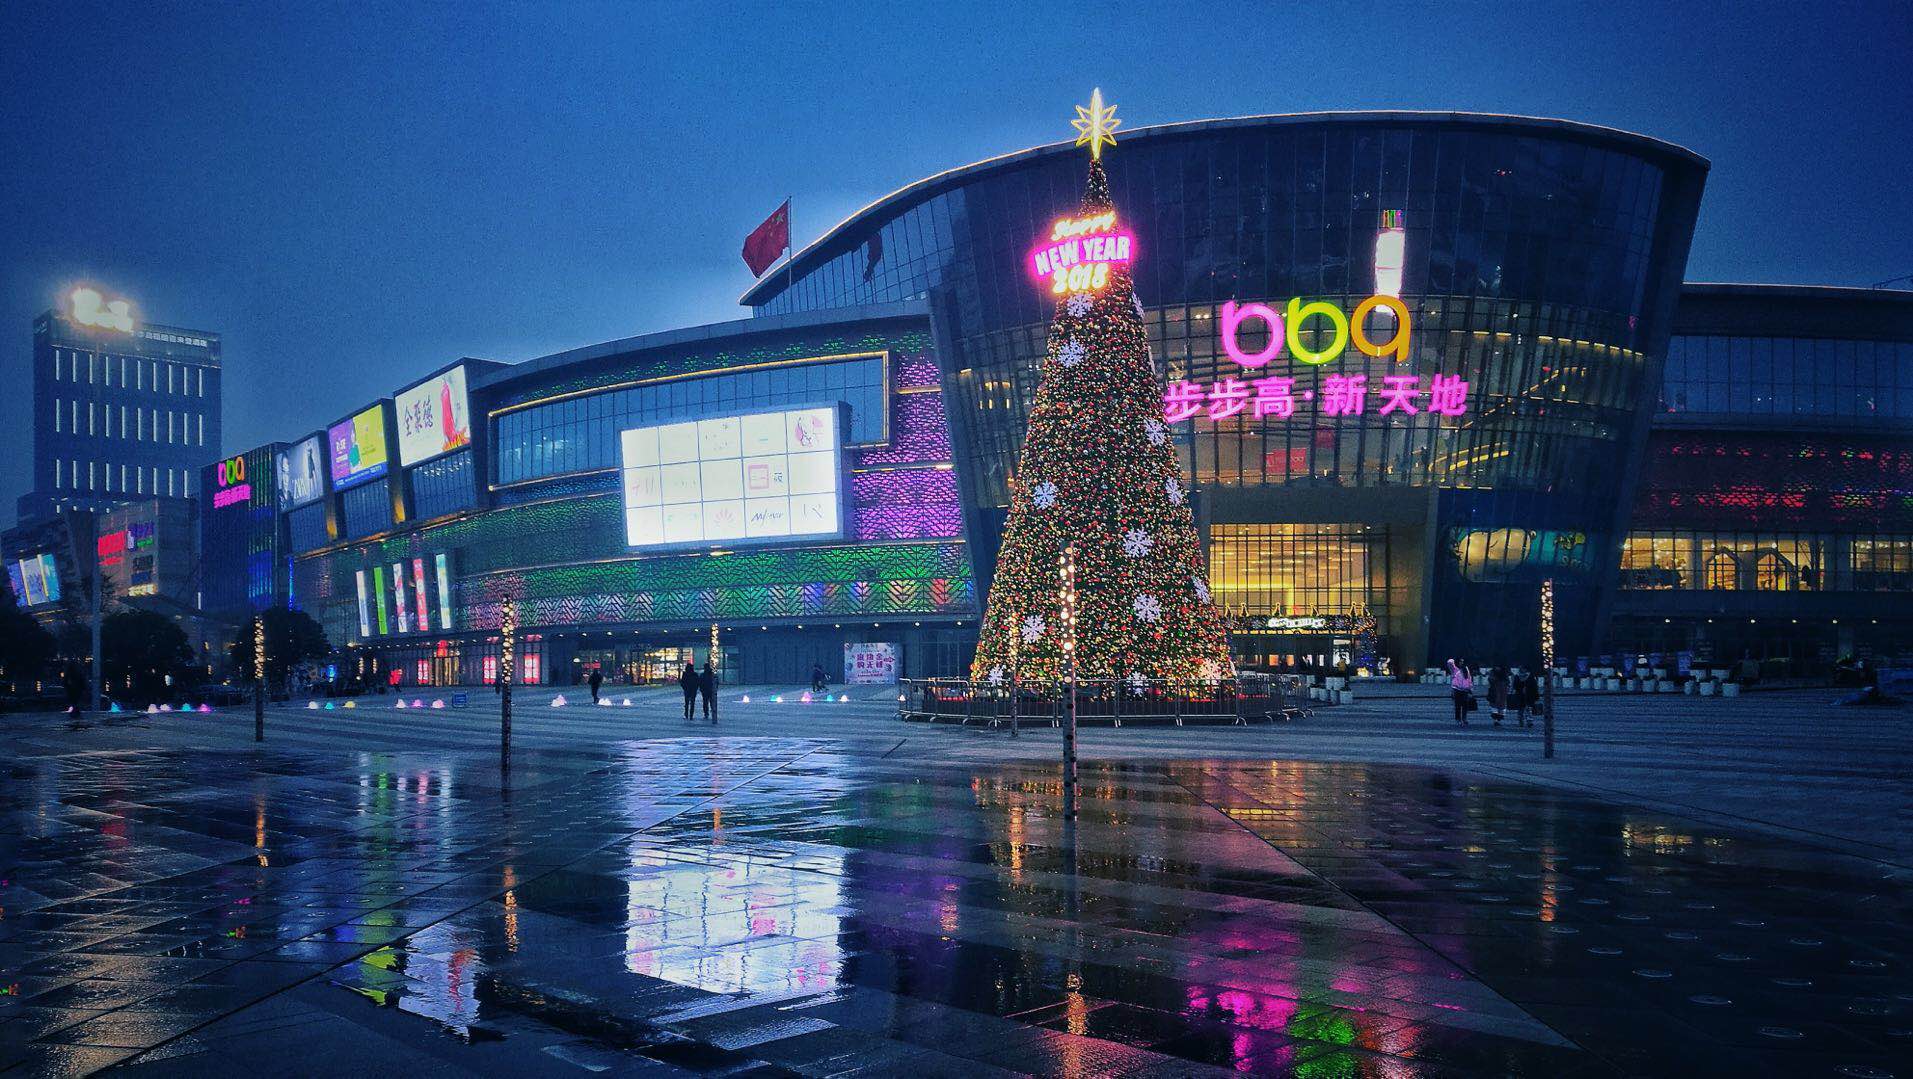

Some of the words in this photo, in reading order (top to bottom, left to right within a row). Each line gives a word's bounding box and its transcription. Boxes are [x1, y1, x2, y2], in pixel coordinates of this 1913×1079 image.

[1034, 240, 1080, 276] NEW
[1082, 236, 1131, 262] YEAR
[1053, 262, 1109, 294] 2018
[1164, 373, 1470, 424] 步步高·新天地
